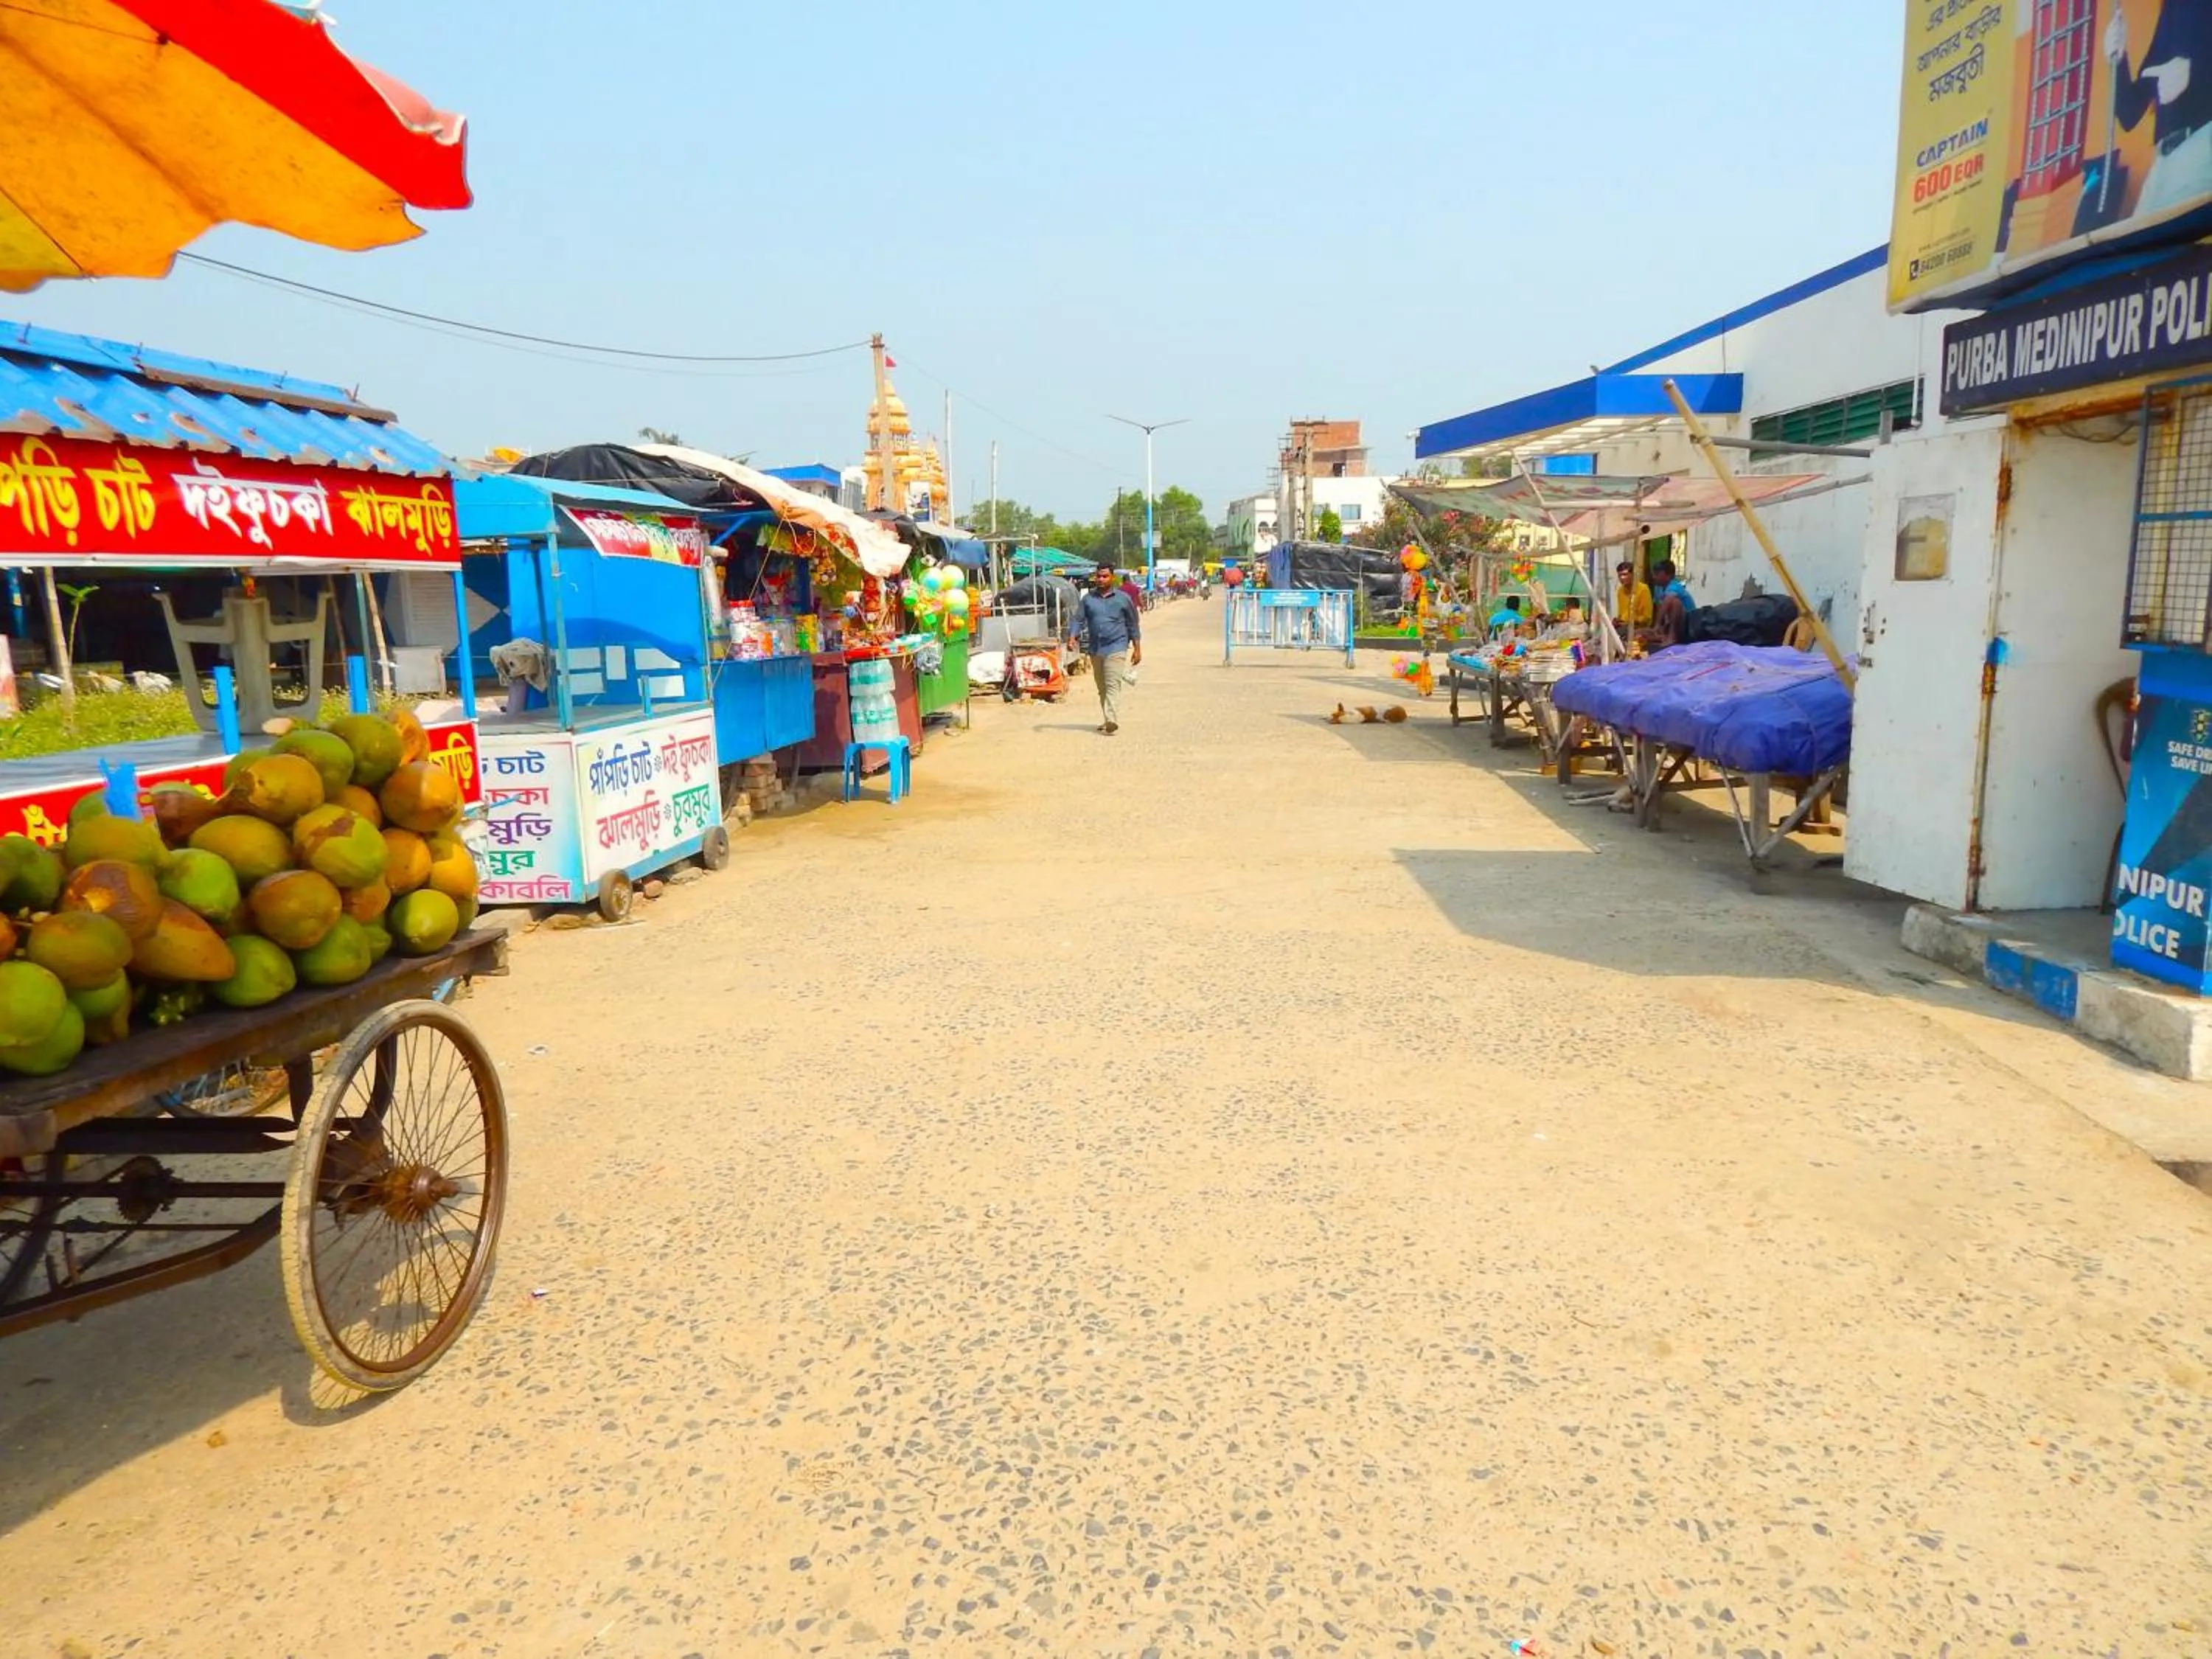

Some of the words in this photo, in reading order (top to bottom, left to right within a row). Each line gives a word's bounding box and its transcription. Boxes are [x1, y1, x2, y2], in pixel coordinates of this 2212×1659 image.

[1916, 117, 1989, 167] CAPTAIN
[1913, 163, 1952, 203] 600
[1953, 152, 1985, 184] EQR
[1944, 329, 2007, 393] PURBA
[2012, 293, 2143, 379] MEDINIPUR
[83, 447, 156, 540] চাট
[338, 483, 452, 557] ঝালমুড়ি
[495, 750, 546, 775] চাট
[630, 740, 653, 784] চাট
[2167, 740, 2194, 757] SAFE
[2170, 754, 2199, 773] SAVE
[597, 790, 661, 850] ঝালমুড়ি
[2117, 861, 2205, 917] NIPUR
